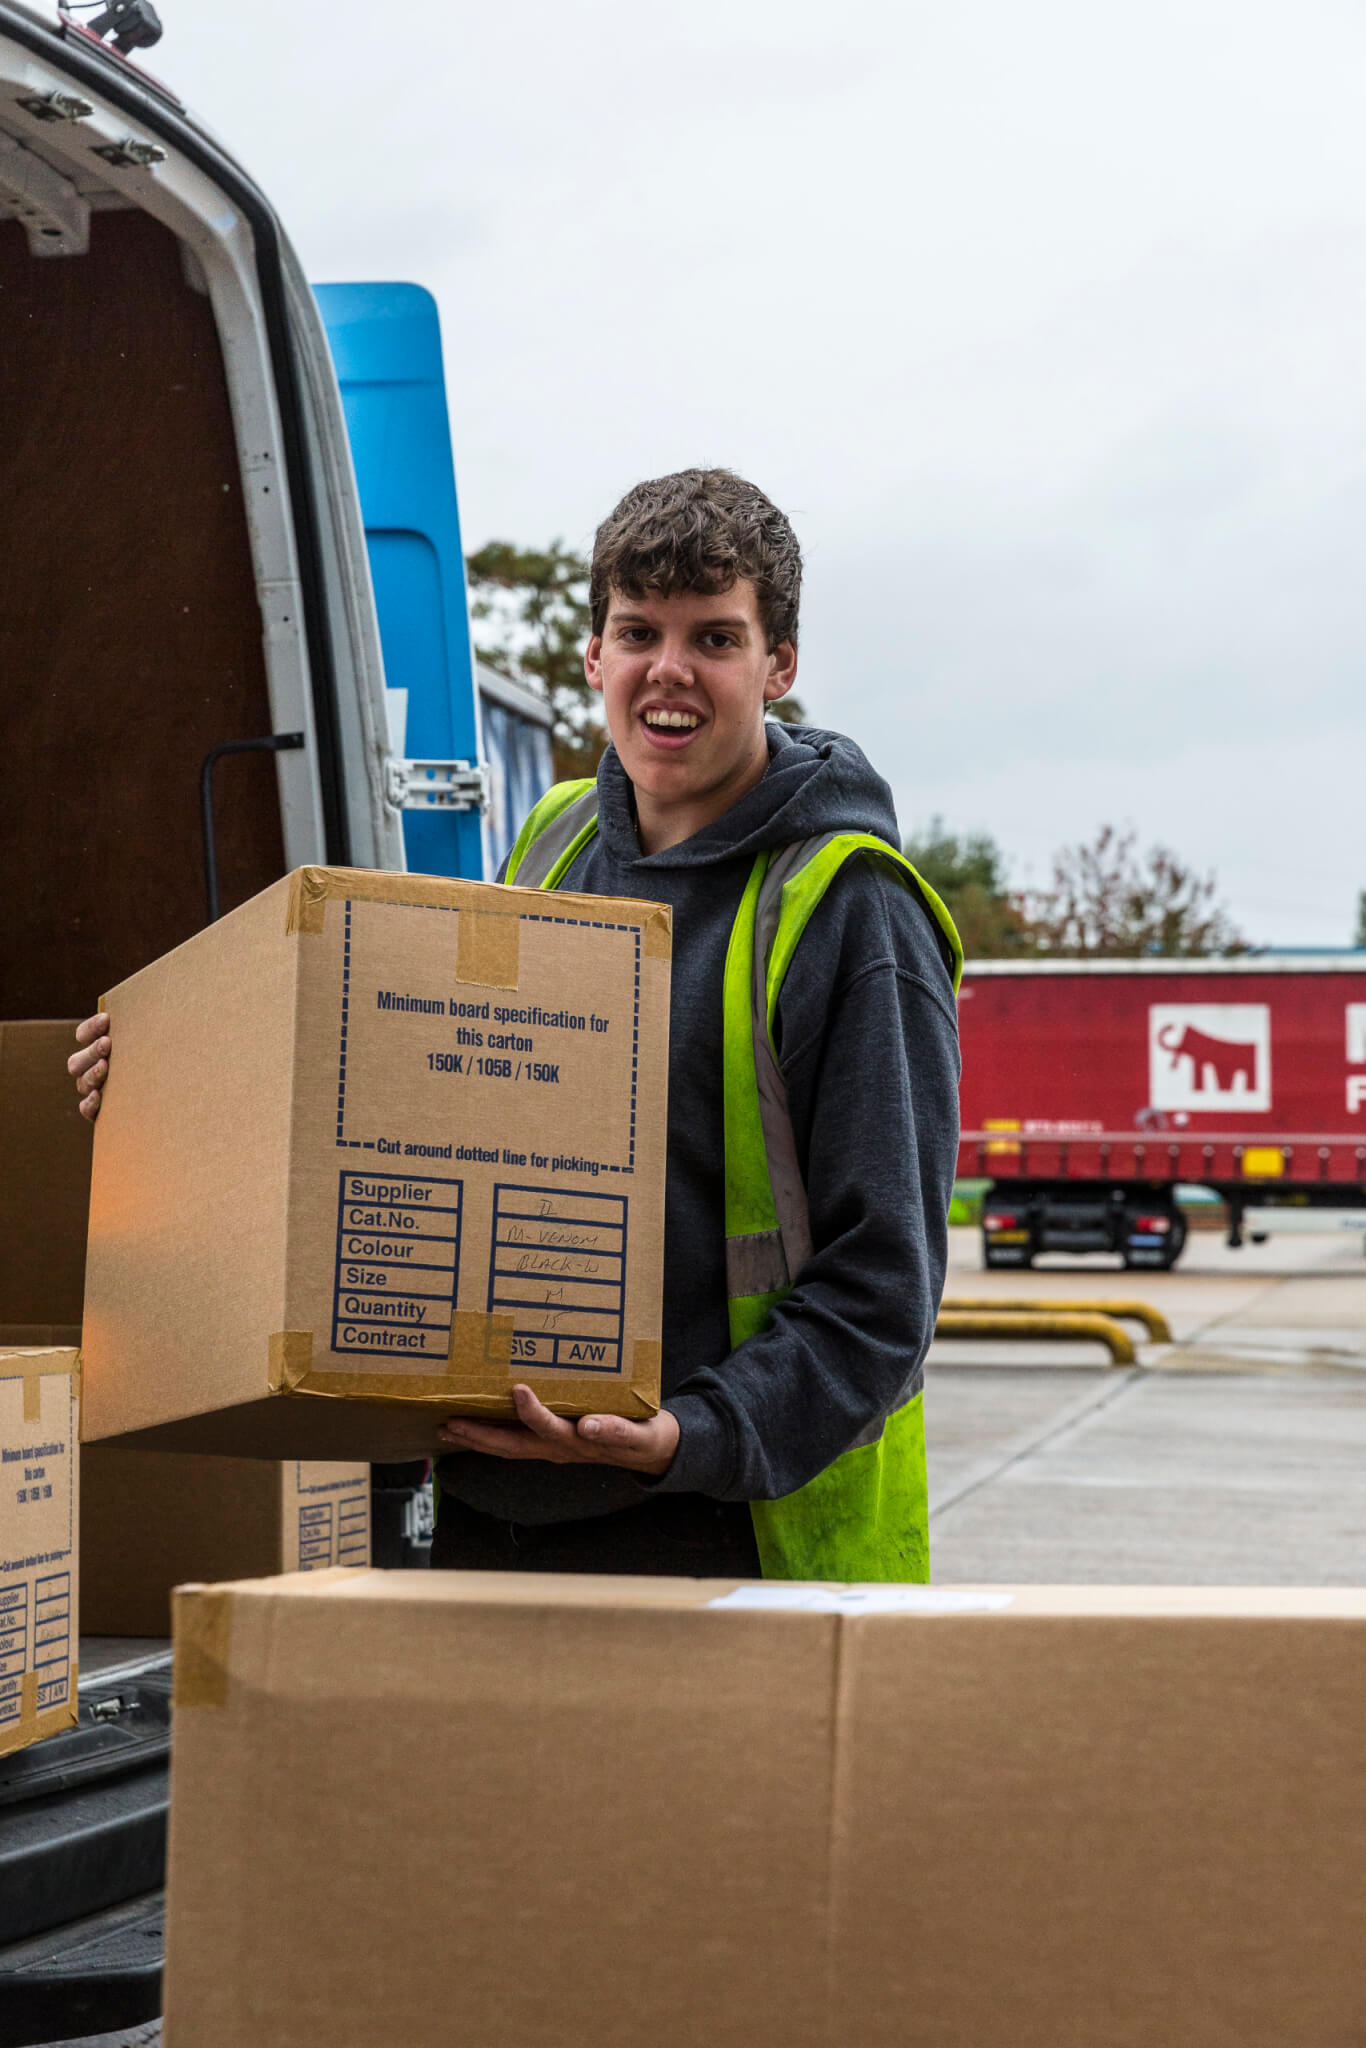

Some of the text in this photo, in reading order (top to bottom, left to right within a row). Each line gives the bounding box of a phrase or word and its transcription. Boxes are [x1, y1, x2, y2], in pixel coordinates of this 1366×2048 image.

[377, 991, 610, 1033] Minimum board specification for
[456, 1027, 533, 1053] this carton
[426, 1053, 463, 1073] 150K
[476, 1058, 512, 1078] 105B
[525, 1063, 560, 1083] 150K
[377, 1138, 600, 1176] Cut around dotted line for picking
[351, 1179, 433, 1203] Supplier
[349, 1208, 420, 1230] Cat.No.
[348, 1237, 414, 1258] Colour
[346, 1267, 387, 1286] Size
[344, 1296, 427, 1323] Quantity
[343, 1326, 426, 1349] Contract
[569, 1343, 606, 1361] A/W
